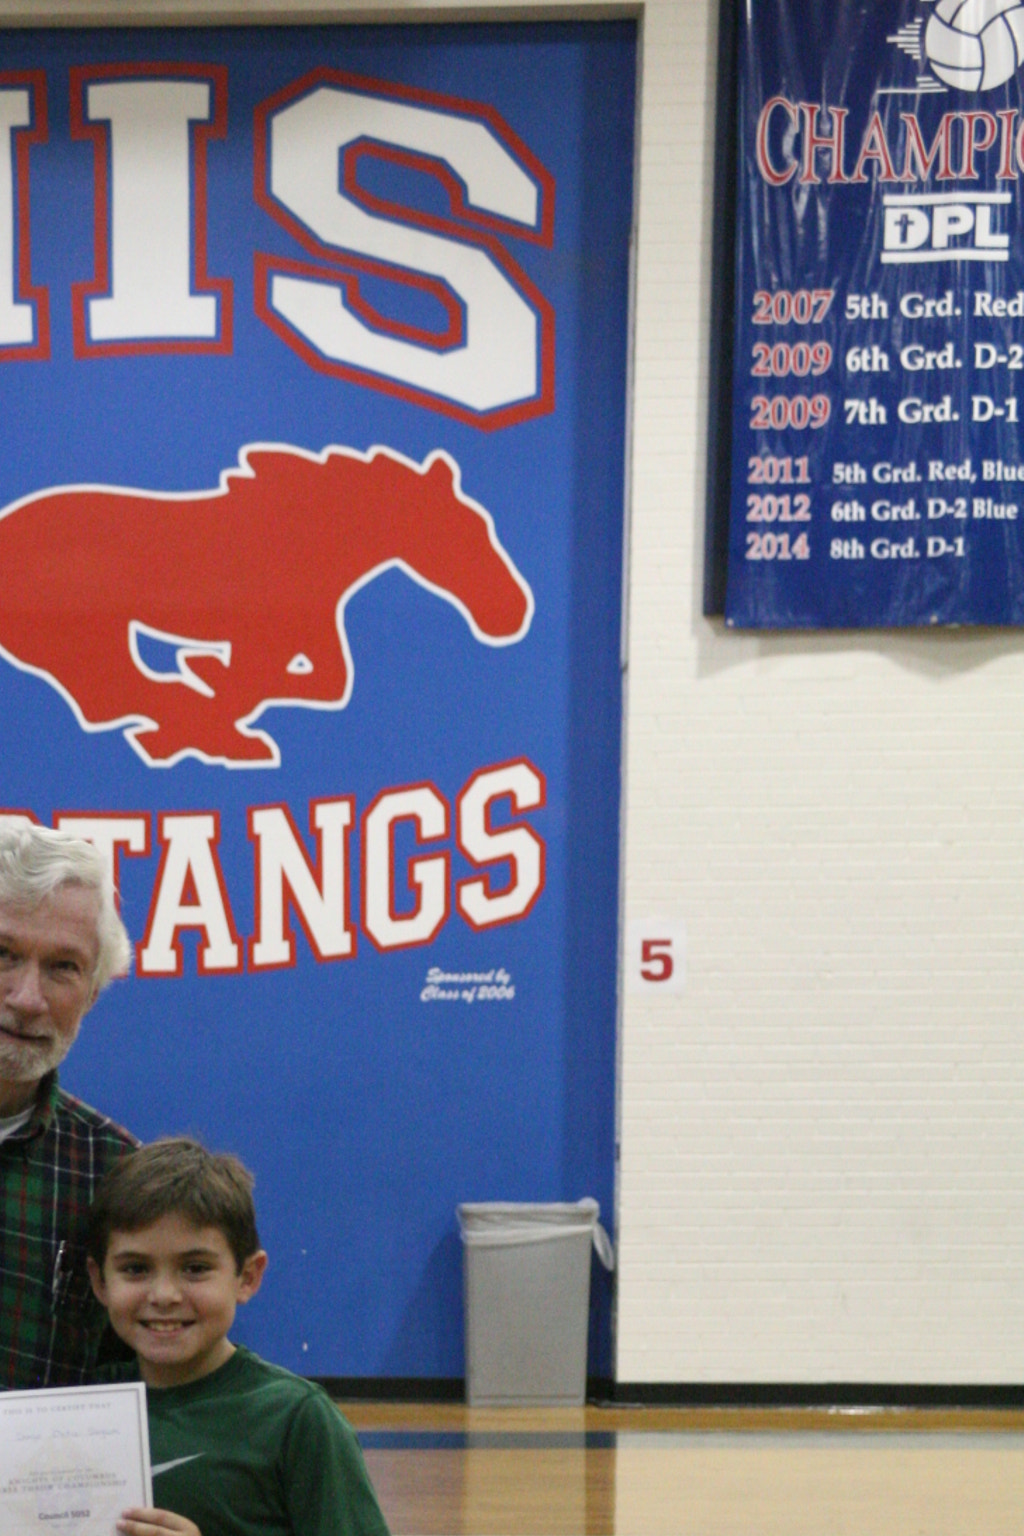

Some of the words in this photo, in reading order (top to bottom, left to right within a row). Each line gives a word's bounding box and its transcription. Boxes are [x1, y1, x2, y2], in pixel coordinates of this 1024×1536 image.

[756, 96, 1024, 186] CHAMPI
[884, 205, 1009, 250] DPL
[752, 289, 834, 325] 2007
[844, 293, 889, 320] 5th
[899, 291, 962, 319] Grd.
[973, 291, 1024, 317] Red
[751, 341, 832, 377] 2009
[845, 345, 890, 373] 6th
[899, 342, 963, 372] Grd.
[974, 343, 1023, 370] D-2
[749, 394, 831, 430] 2009
[843, 397, 887, 425] 7th
[897, 395, 960, 424] Grd.
[971, 396, 1019, 423] D-1
[747, 455, 812, 485] 2011
[832, 462, 867, 484] 5th
[871, 461, 922, 484] Grd.
[927, 459, 977, 484] Red,
[981, 459, 1024, 482] Blue
[745, 493, 812, 523] 2012
[830, 499, 866, 522] 6th
[870, 498, 921, 521] Grd.
[927, 498, 968, 520] D-2
[972, 498, 1019, 520] Blue
[745, 531, 811, 561] 2014
[829, 537, 865, 560] 8th
[870, 536, 920, 559] Grd.
[926, 536, 966, 557] D-1
[425, 966, 495, 985] Sponsored
[495, 967, 511, 986] by
[640, 939, 674, 982] 5
[420, 984, 460, 1002] Class
[461, 985, 477, 1004] of
